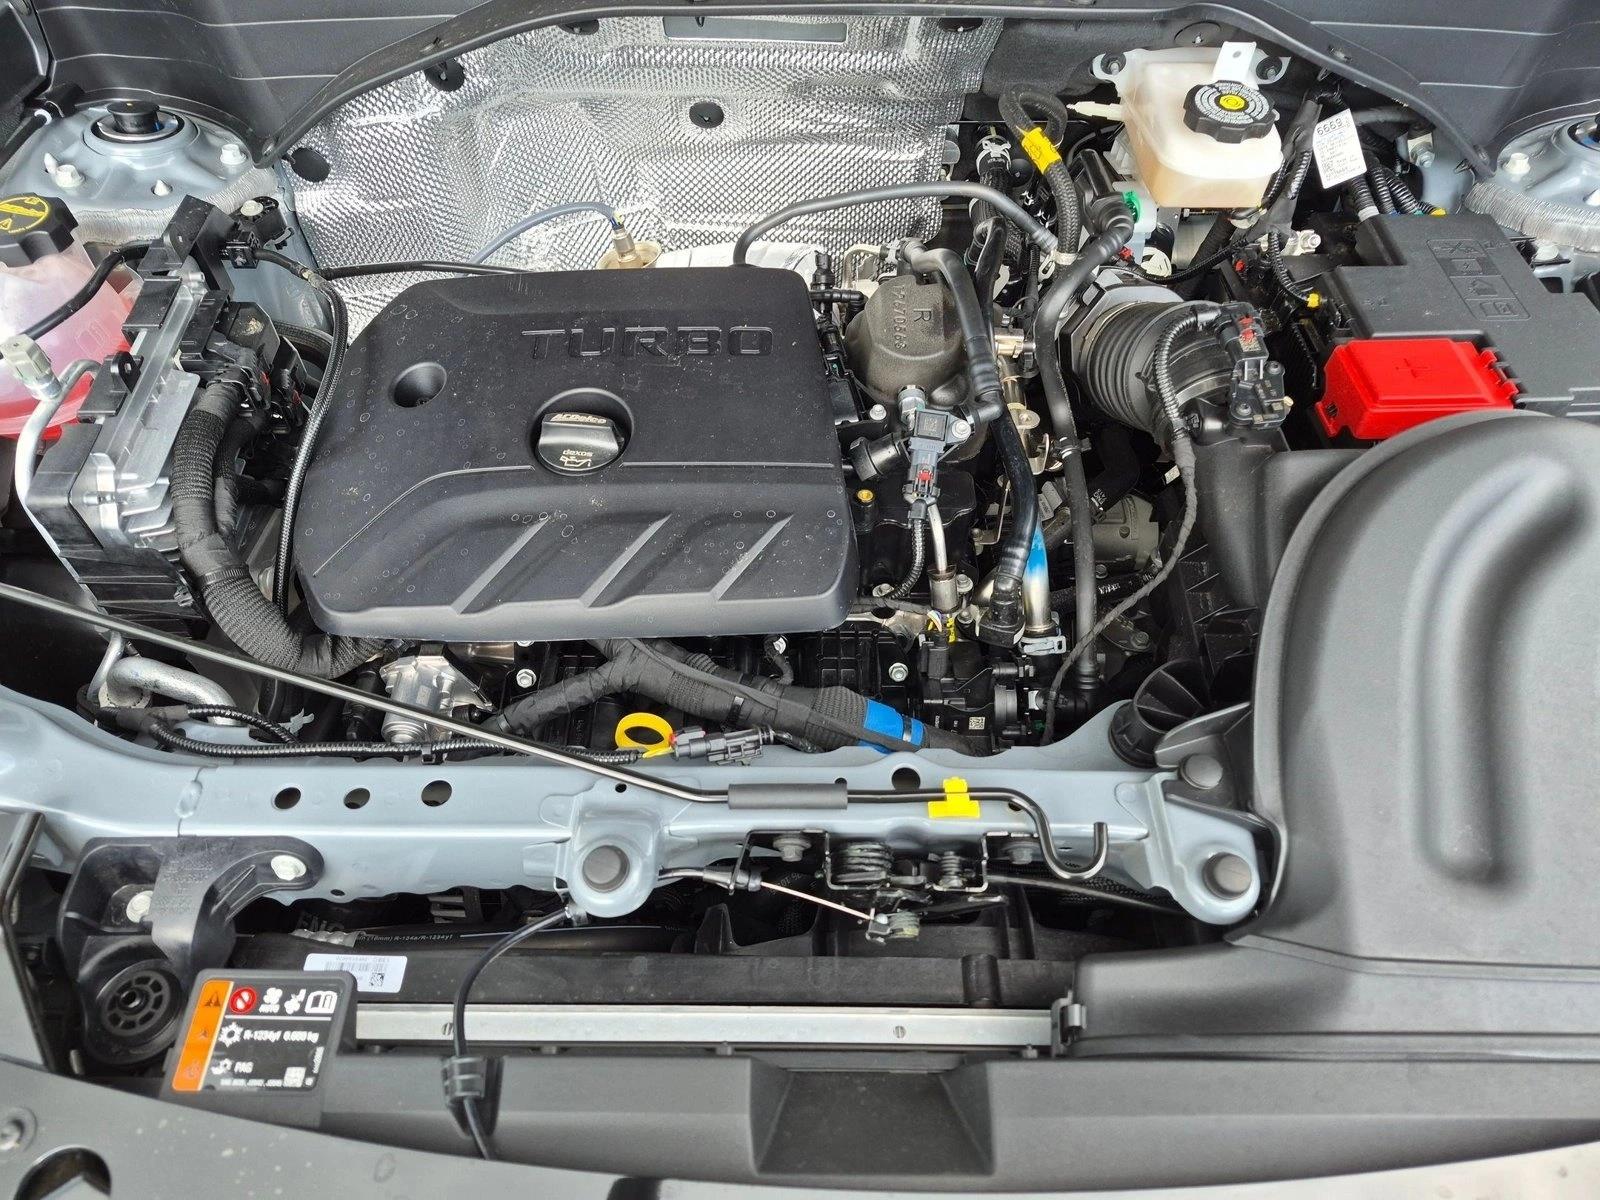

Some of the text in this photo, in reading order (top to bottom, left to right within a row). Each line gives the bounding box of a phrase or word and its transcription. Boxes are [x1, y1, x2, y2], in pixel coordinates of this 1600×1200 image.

[913, 308, 932, 322] R
[521, 326, 773, 360] TURBO
[562, 449, 593, 457] dexos
